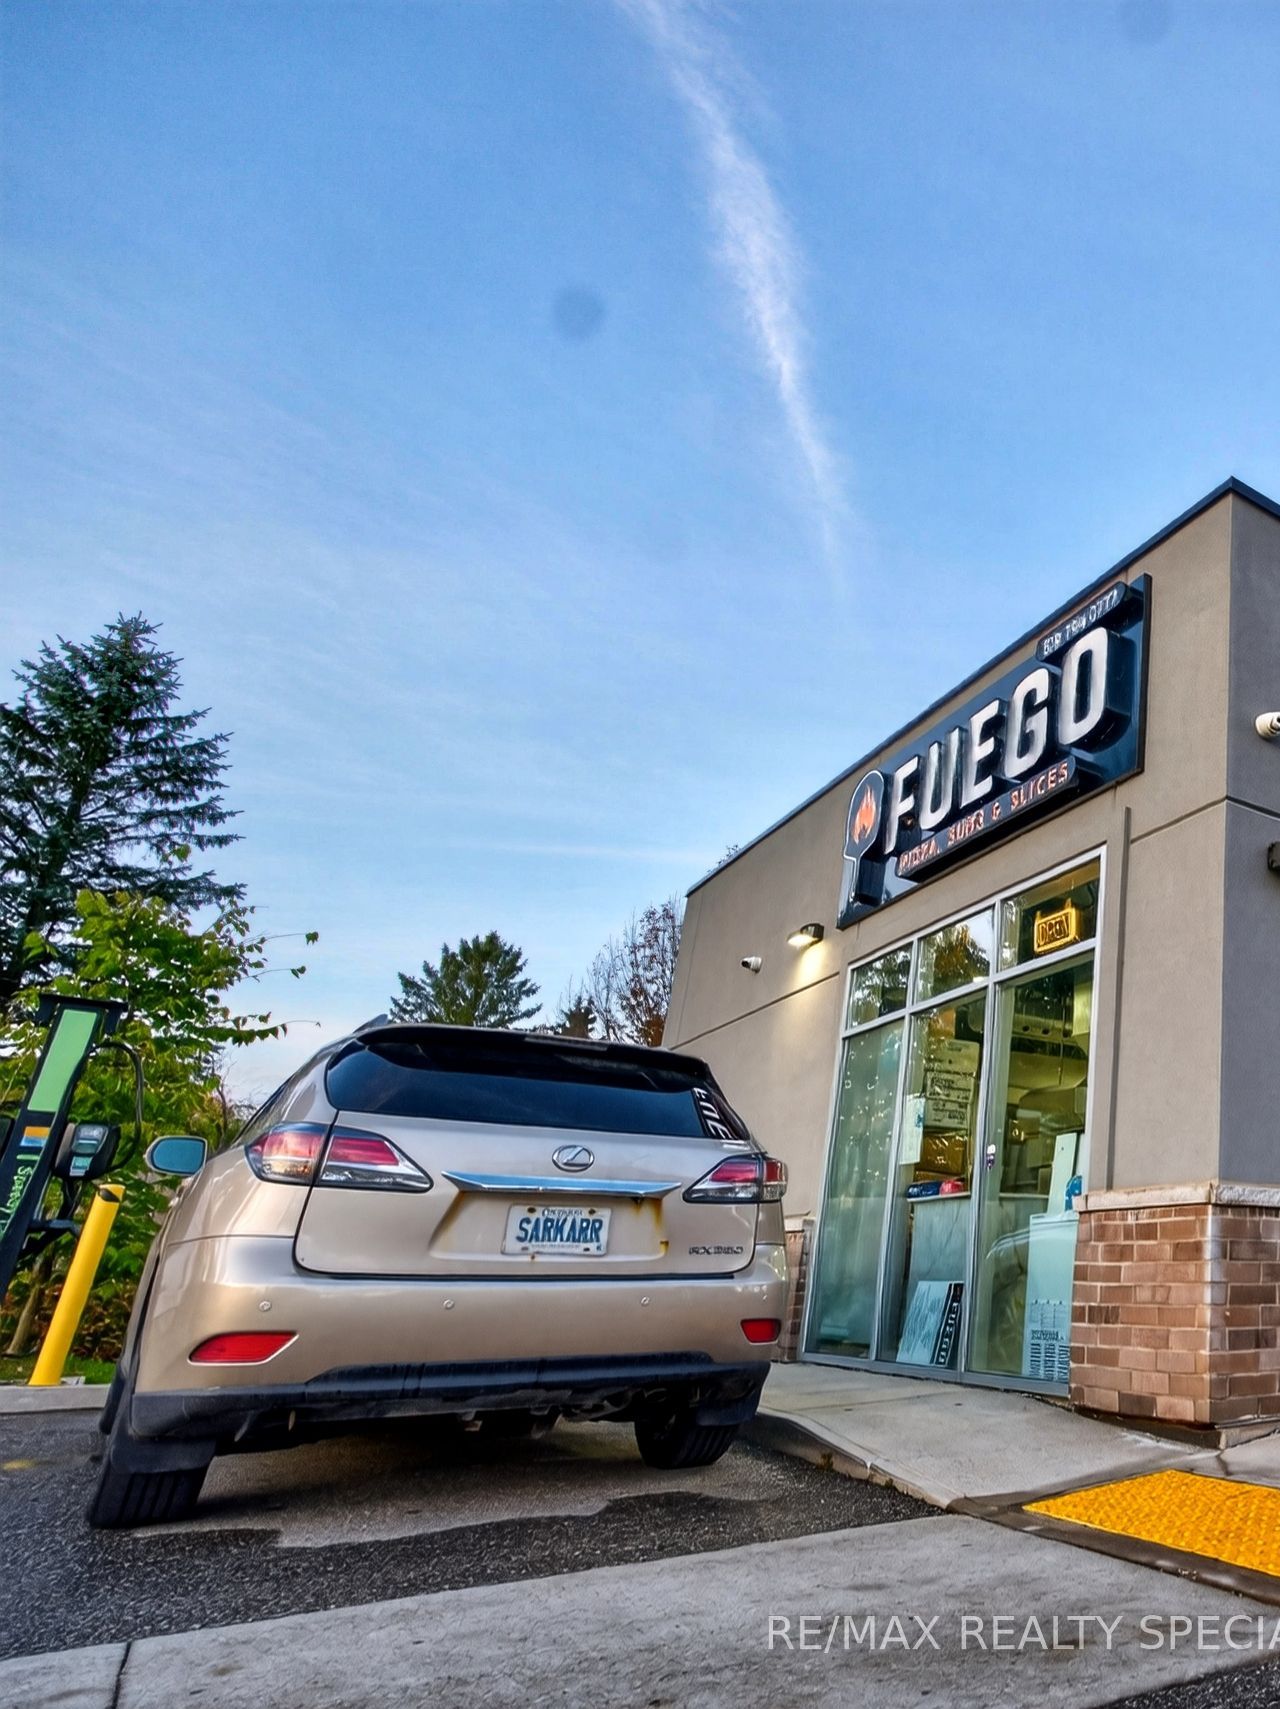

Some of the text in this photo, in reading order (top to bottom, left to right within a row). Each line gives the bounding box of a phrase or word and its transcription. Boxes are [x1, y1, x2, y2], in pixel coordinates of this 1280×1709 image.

[884, 627, 1109, 854] FUEGO
[1010, 762, 1068, 811] SLICES
[515, 1216, 603, 1243] SARKARR
